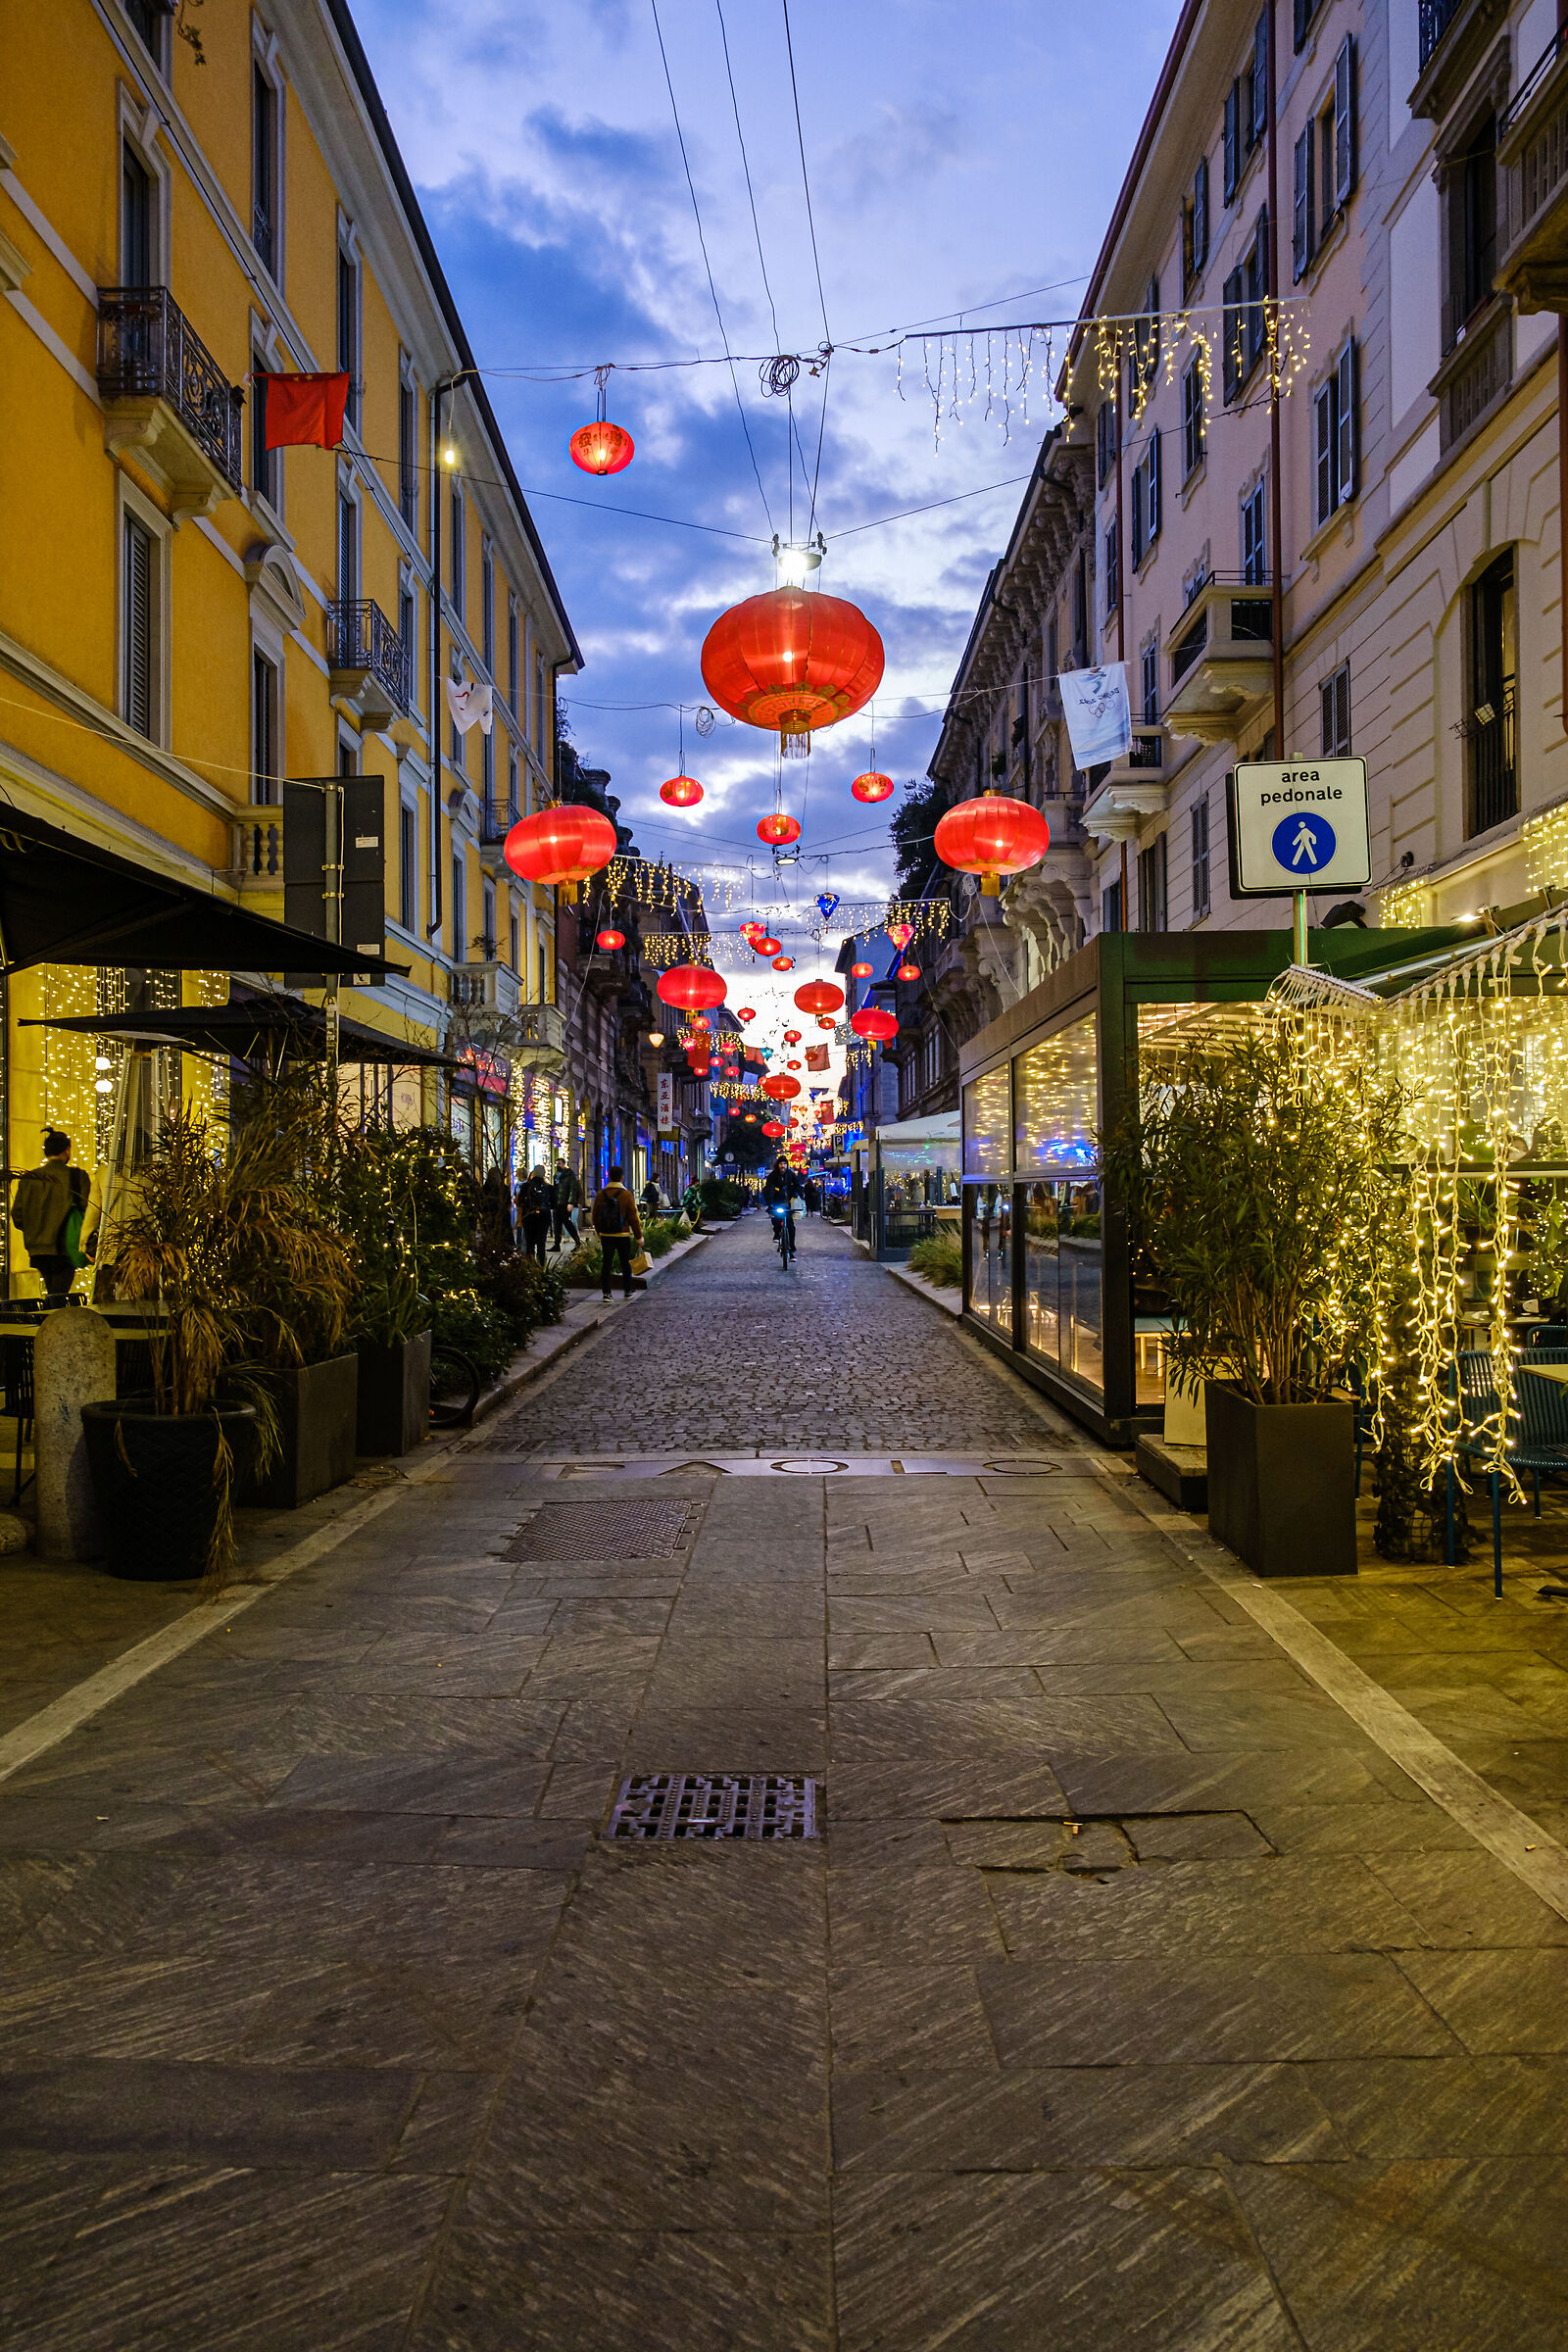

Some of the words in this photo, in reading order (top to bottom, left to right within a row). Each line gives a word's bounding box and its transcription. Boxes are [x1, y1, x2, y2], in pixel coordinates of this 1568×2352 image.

[1281, 770, 1320, 783] area
[1260, 786, 1343, 807] pedonale
[557, 1459, 1064, 1480] PAOLO
